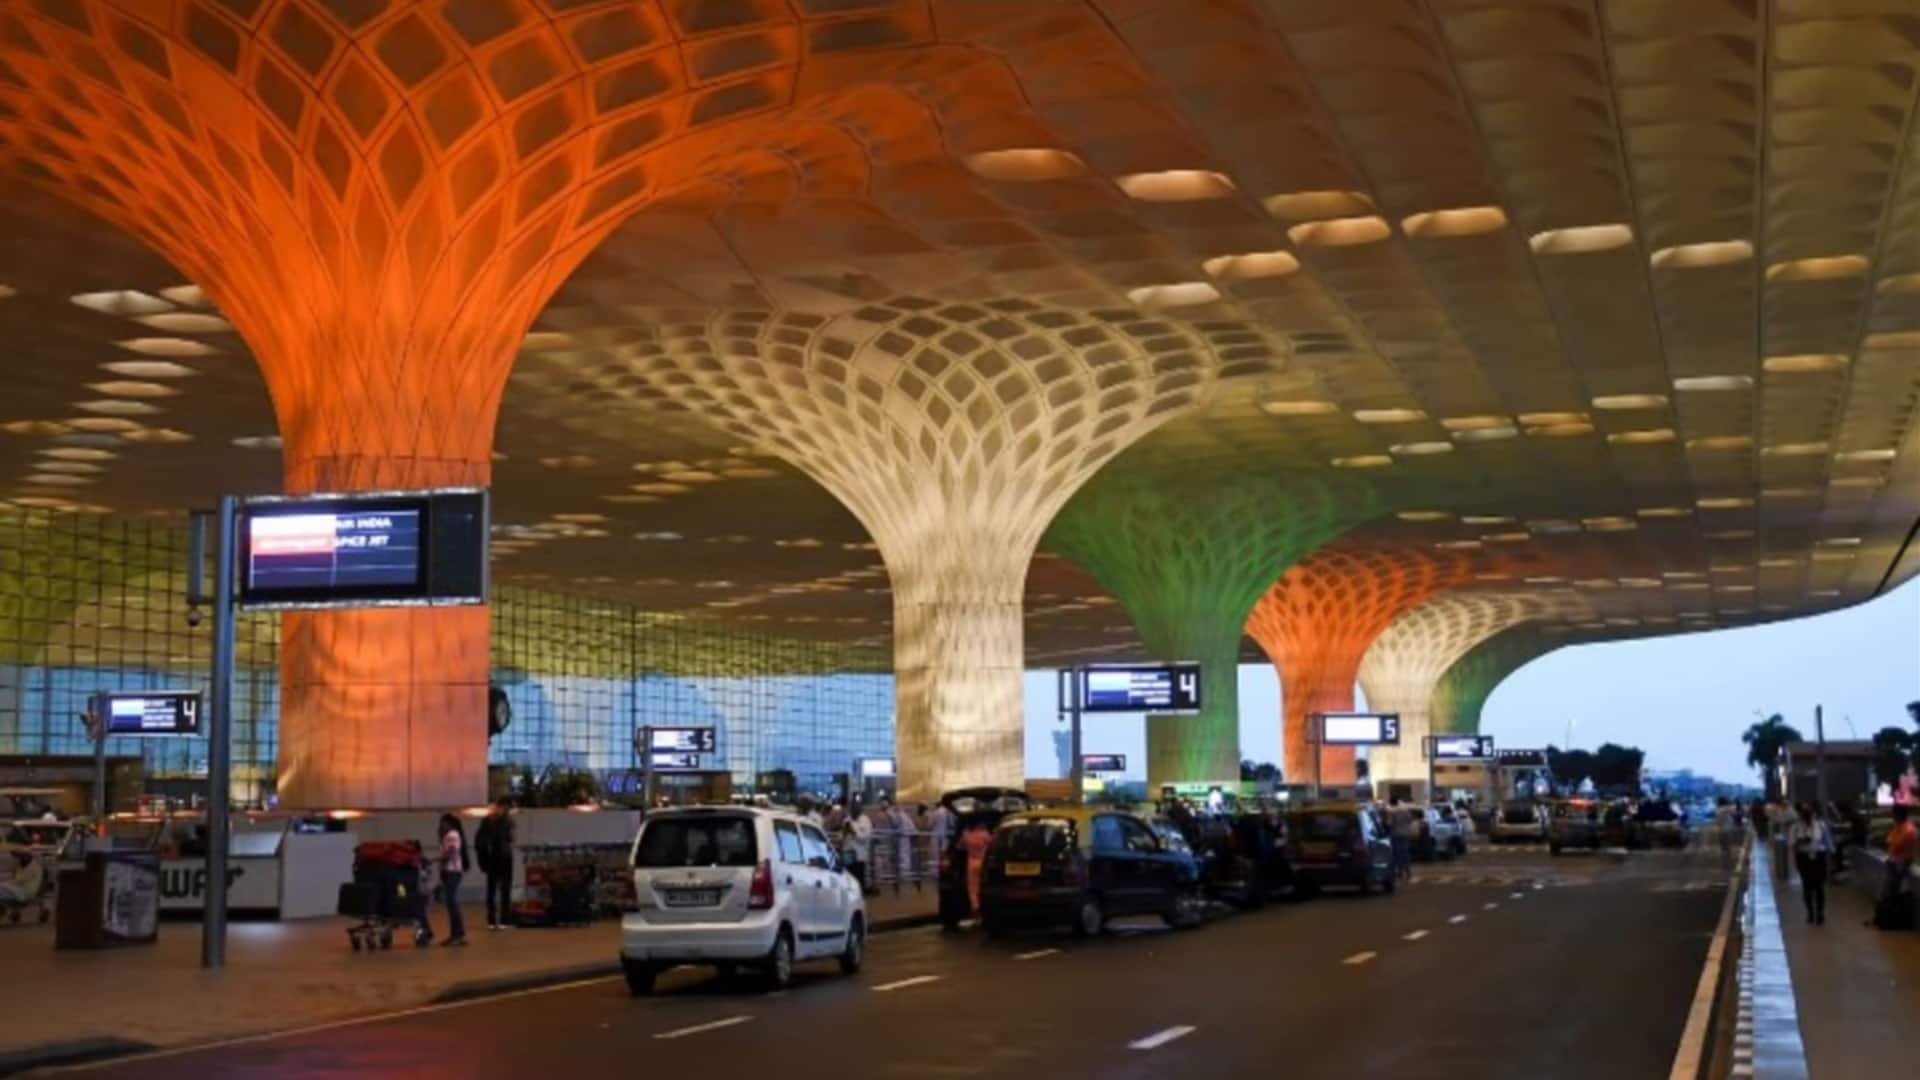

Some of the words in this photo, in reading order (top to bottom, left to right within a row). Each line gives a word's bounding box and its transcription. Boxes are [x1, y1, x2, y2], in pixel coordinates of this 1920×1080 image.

[358, 516, 392, 529] INDIA
[368, 535, 390, 547] JET
[1180, 673, 1196, 703] 4
[182, 700, 196, 726] 4
[1385, 719, 1396, 739] 5
[703, 730, 712, 749] 5
